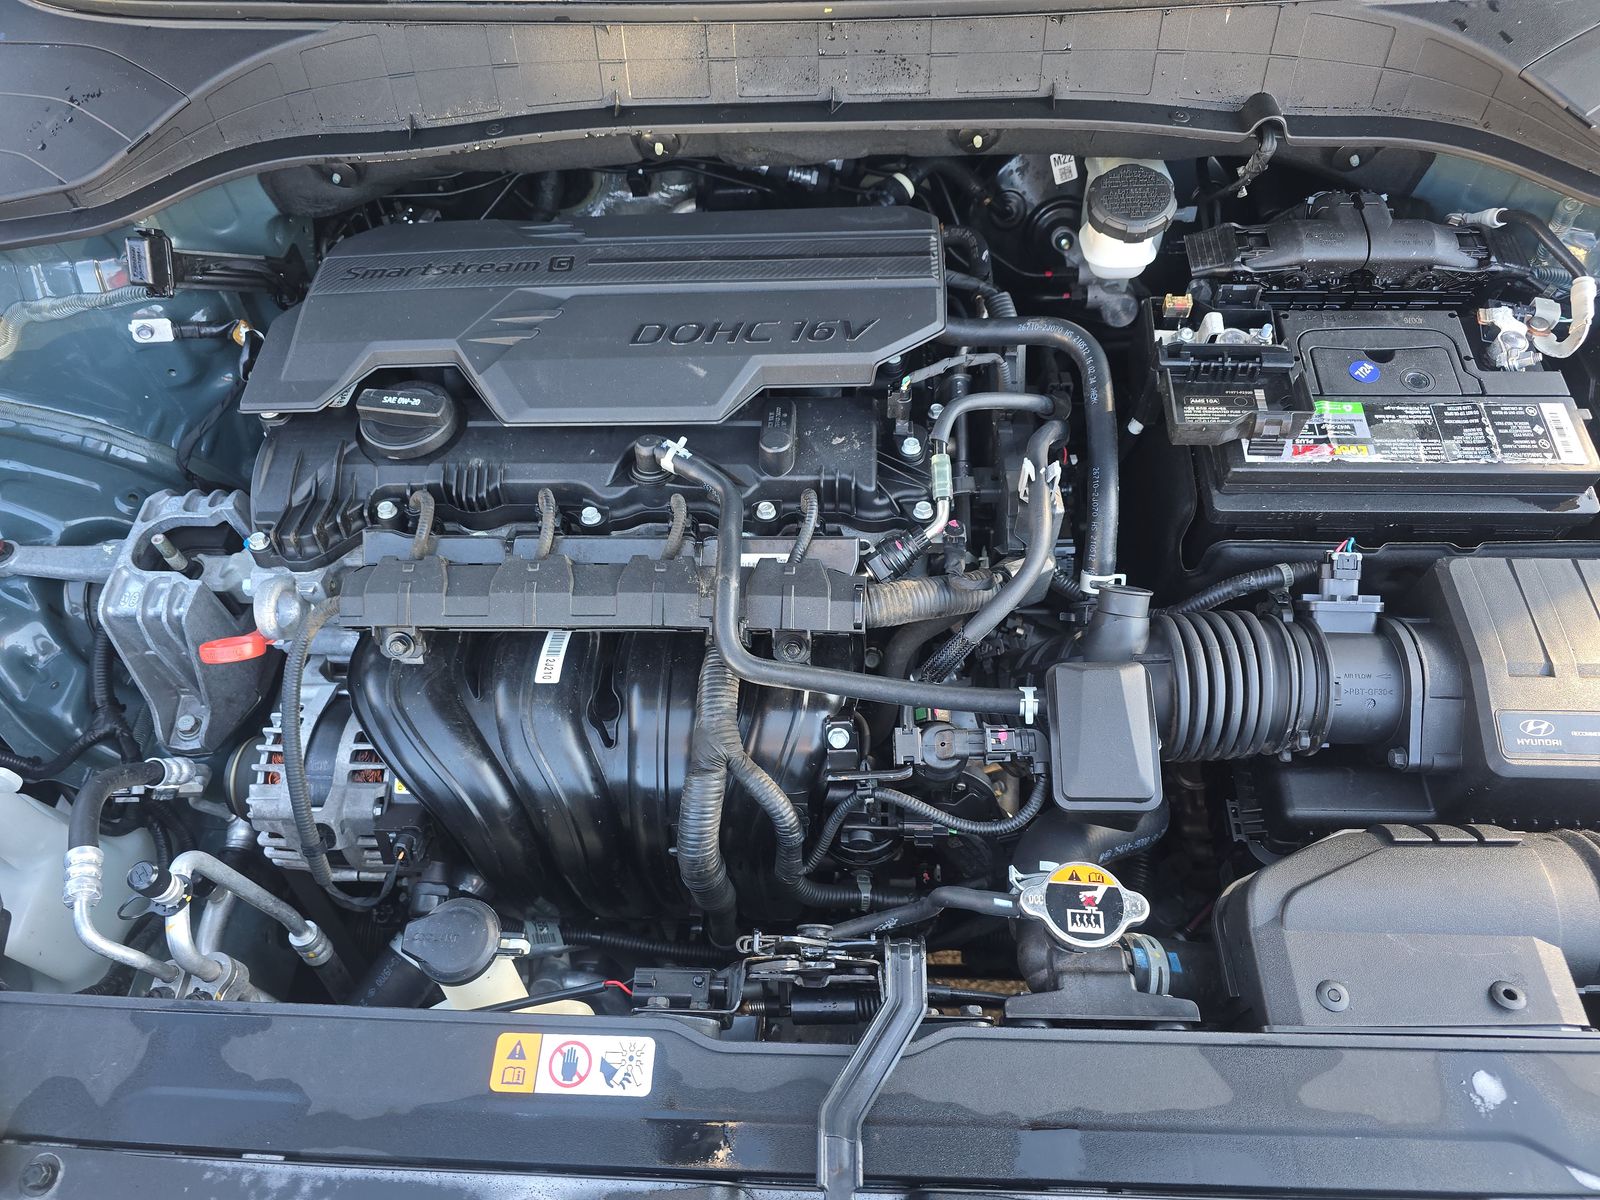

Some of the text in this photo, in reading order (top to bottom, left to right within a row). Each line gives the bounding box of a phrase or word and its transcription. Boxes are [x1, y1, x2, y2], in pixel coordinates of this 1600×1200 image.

[341, 260, 540, 281] Smartstream
[628, 317, 881, 347] DOHC 16V
[1354, 363, 1375, 379] 7/24
[382, 396, 421, 406] SAE 0W-20
[1091, 467, 1100, 517] 26710-2J070
[1090, 521, 1098, 531] HS
[542, 658, 556, 680] 2J210
[1517, 738, 1562, 746] HYUNDAI
